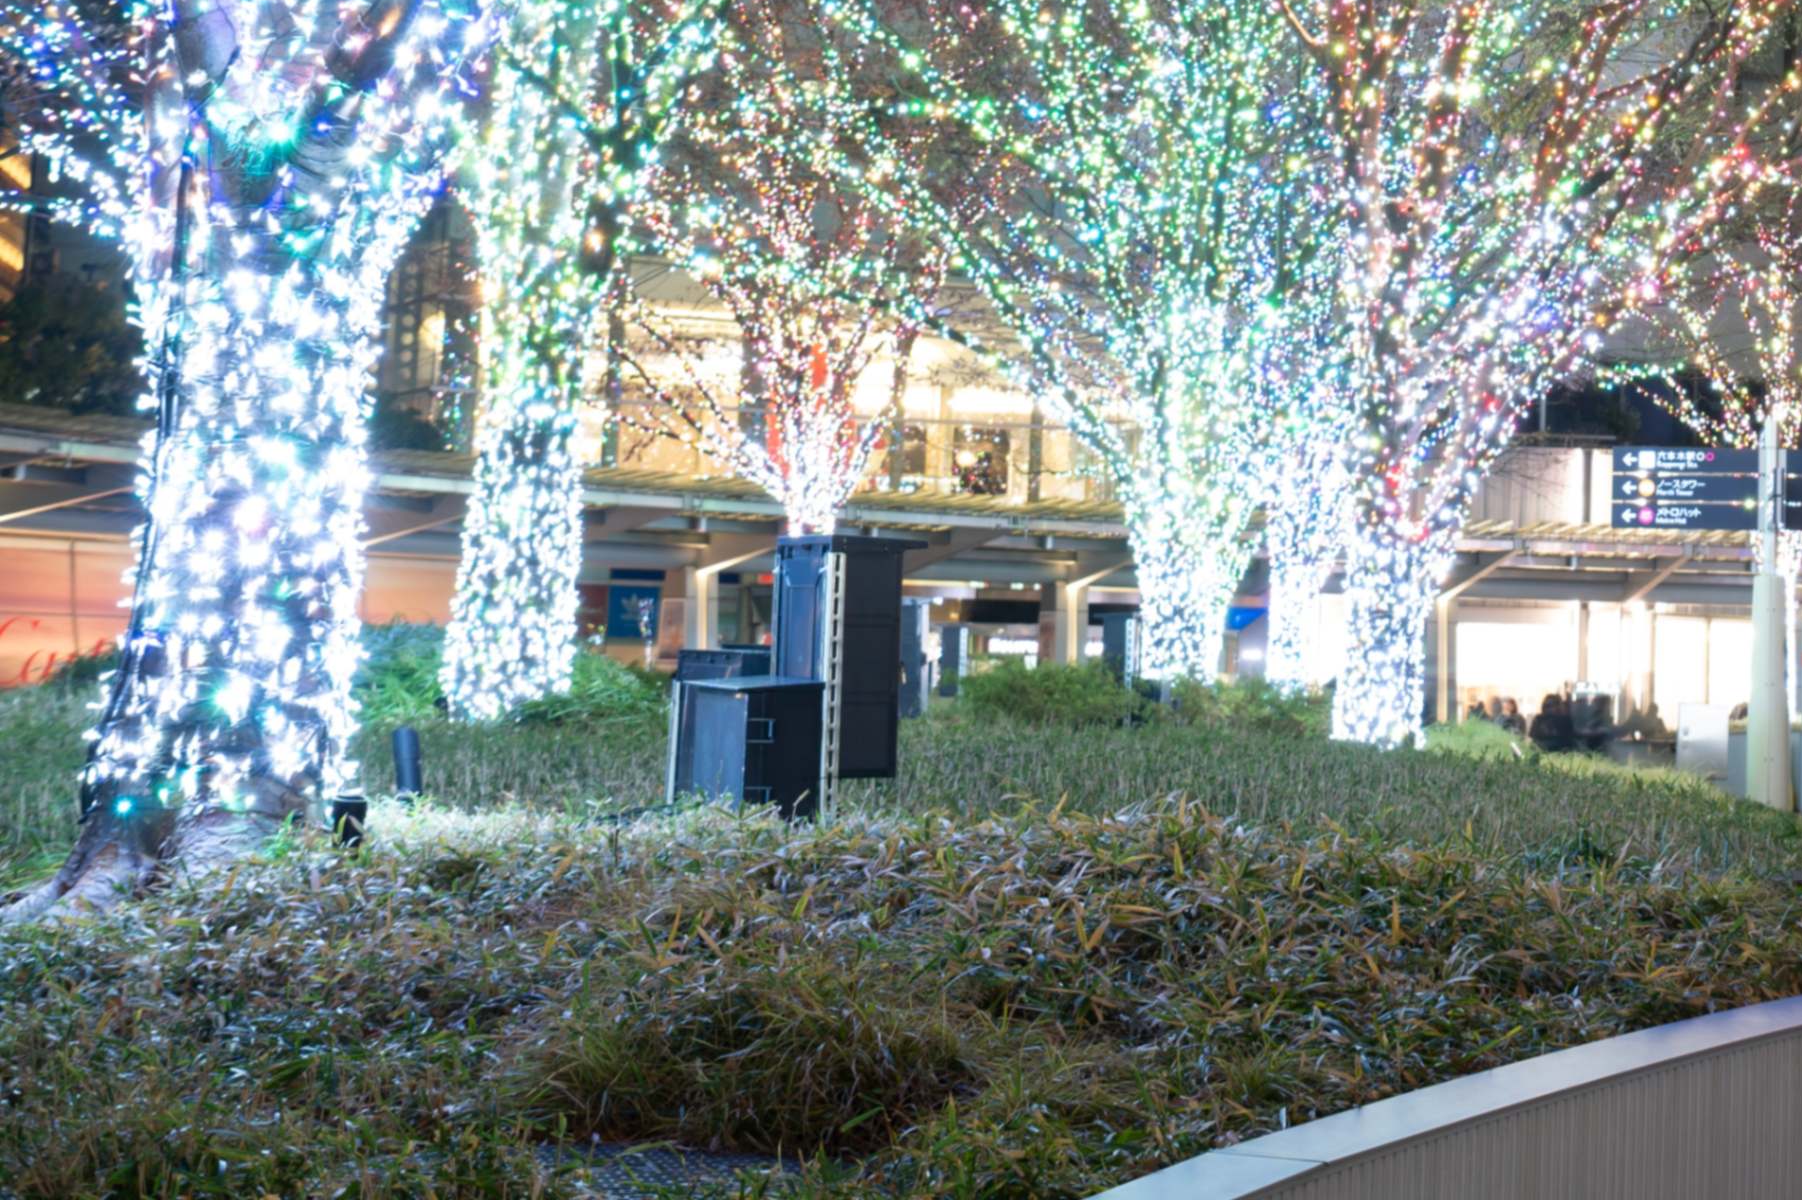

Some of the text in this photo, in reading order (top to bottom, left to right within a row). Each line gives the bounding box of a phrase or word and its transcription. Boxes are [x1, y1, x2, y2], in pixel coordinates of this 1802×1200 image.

[1657, 479, 1706, 490] ノースタワー
